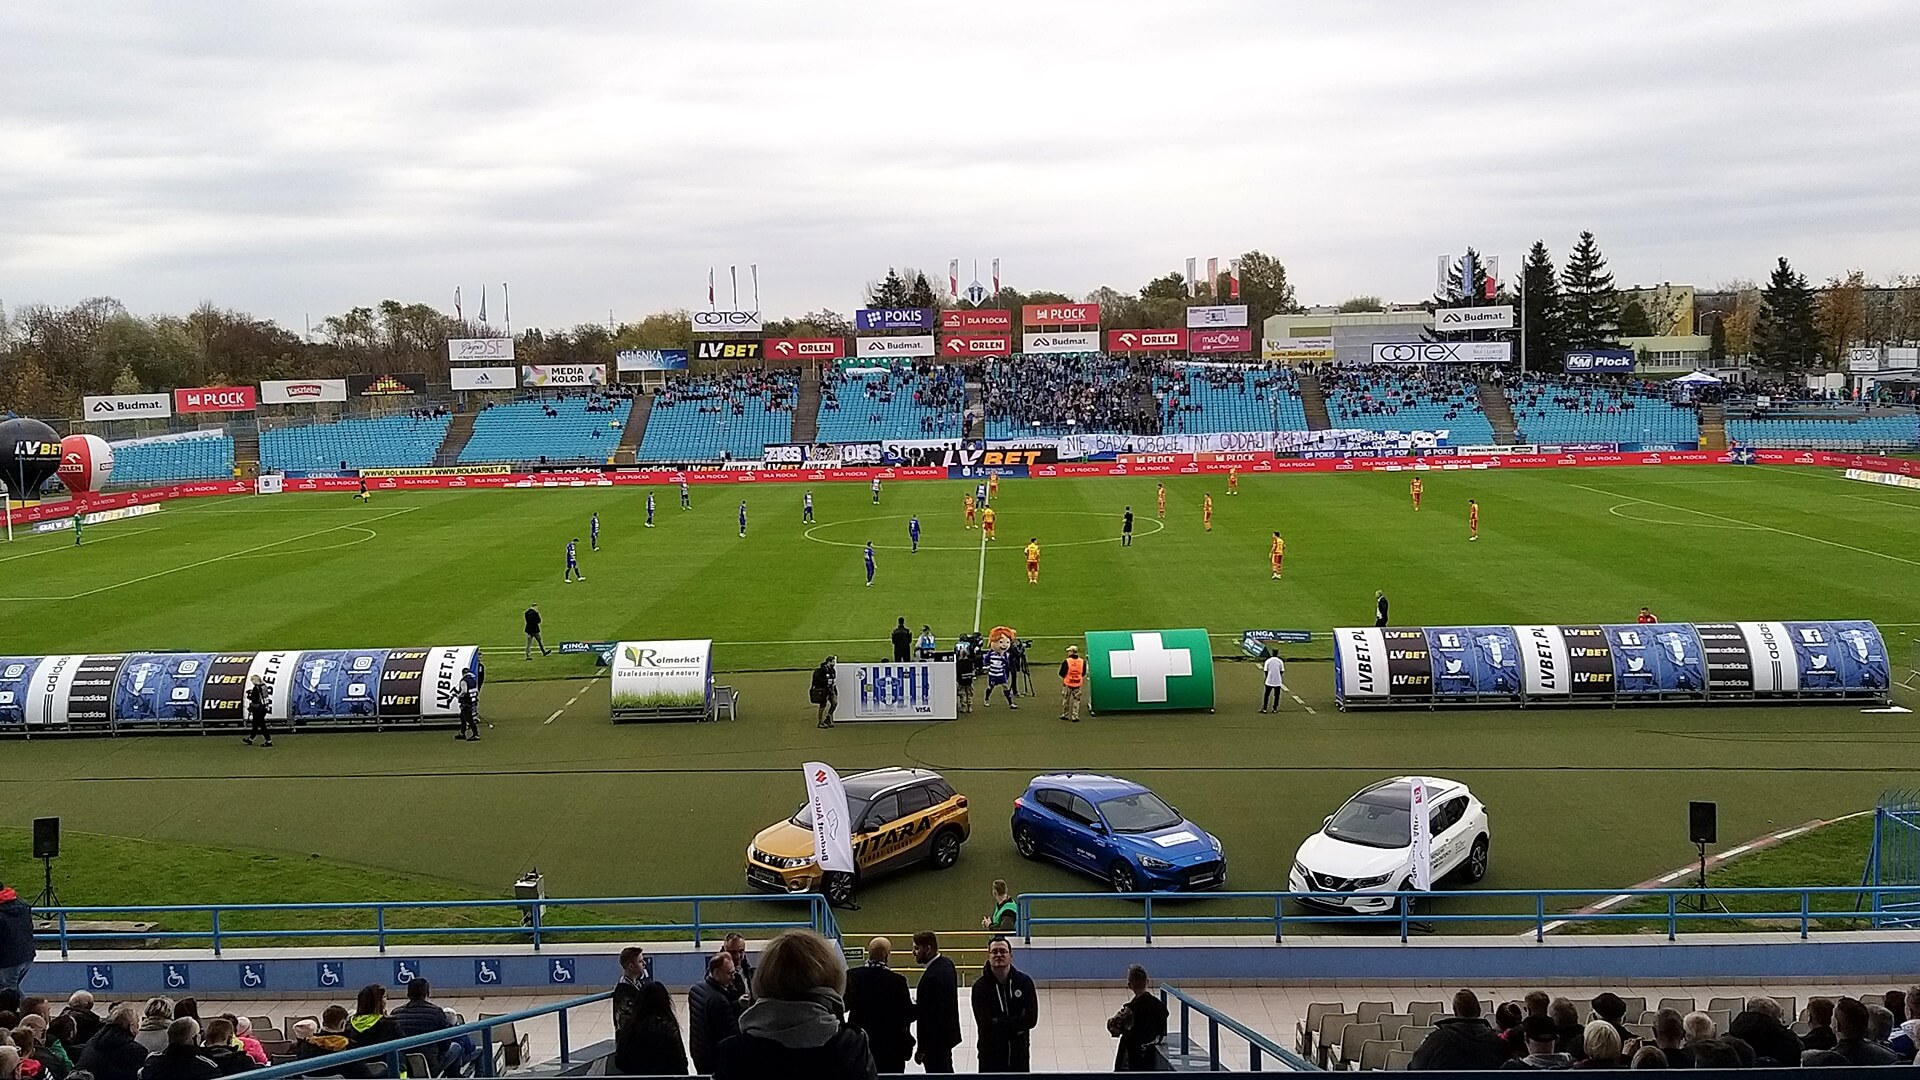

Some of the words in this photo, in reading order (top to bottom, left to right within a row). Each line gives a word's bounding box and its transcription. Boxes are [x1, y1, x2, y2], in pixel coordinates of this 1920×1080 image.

[885, 310, 922, 321] POKIS
[1051, 309, 1086, 319] PŁOCK
[1464, 312, 1506, 321] Budmat.
[1052, 338, 1088, 346] Budmat.
[1144, 336, 1176, 344] ORLEN
[620, 350, 664, 363] SELENKA
[1568, 356, 1591, 368] KM
[287, 385, 322, 396] Kasztelan
[376, 379, 398, 391] pik
[204, 392, 245, 405] PŁOCK
[117, 401, 163, 411] Budmat.
[1067, 436, 1088, 451] NIE
[764, 446, 801, 462] ZKS
[845, 444, 881, 461] OKS
[1314, 451, 1336, 459] POKIS
[1353, 450, 1375, 458] POKIS
[435, 466, 509, 475] WWW.ROLMARKET.PL
[1758, 624, 1779, 659] adidas
[638, 648, 700, 667] Rolmarket
[1352, 630, 1374, 693] LVBET.PL
[1531, 627, 1556, 689] LVBET.PL
[47, 657, 70, 692] adidas
[436, 648, 459, 709] LVBET.PL
